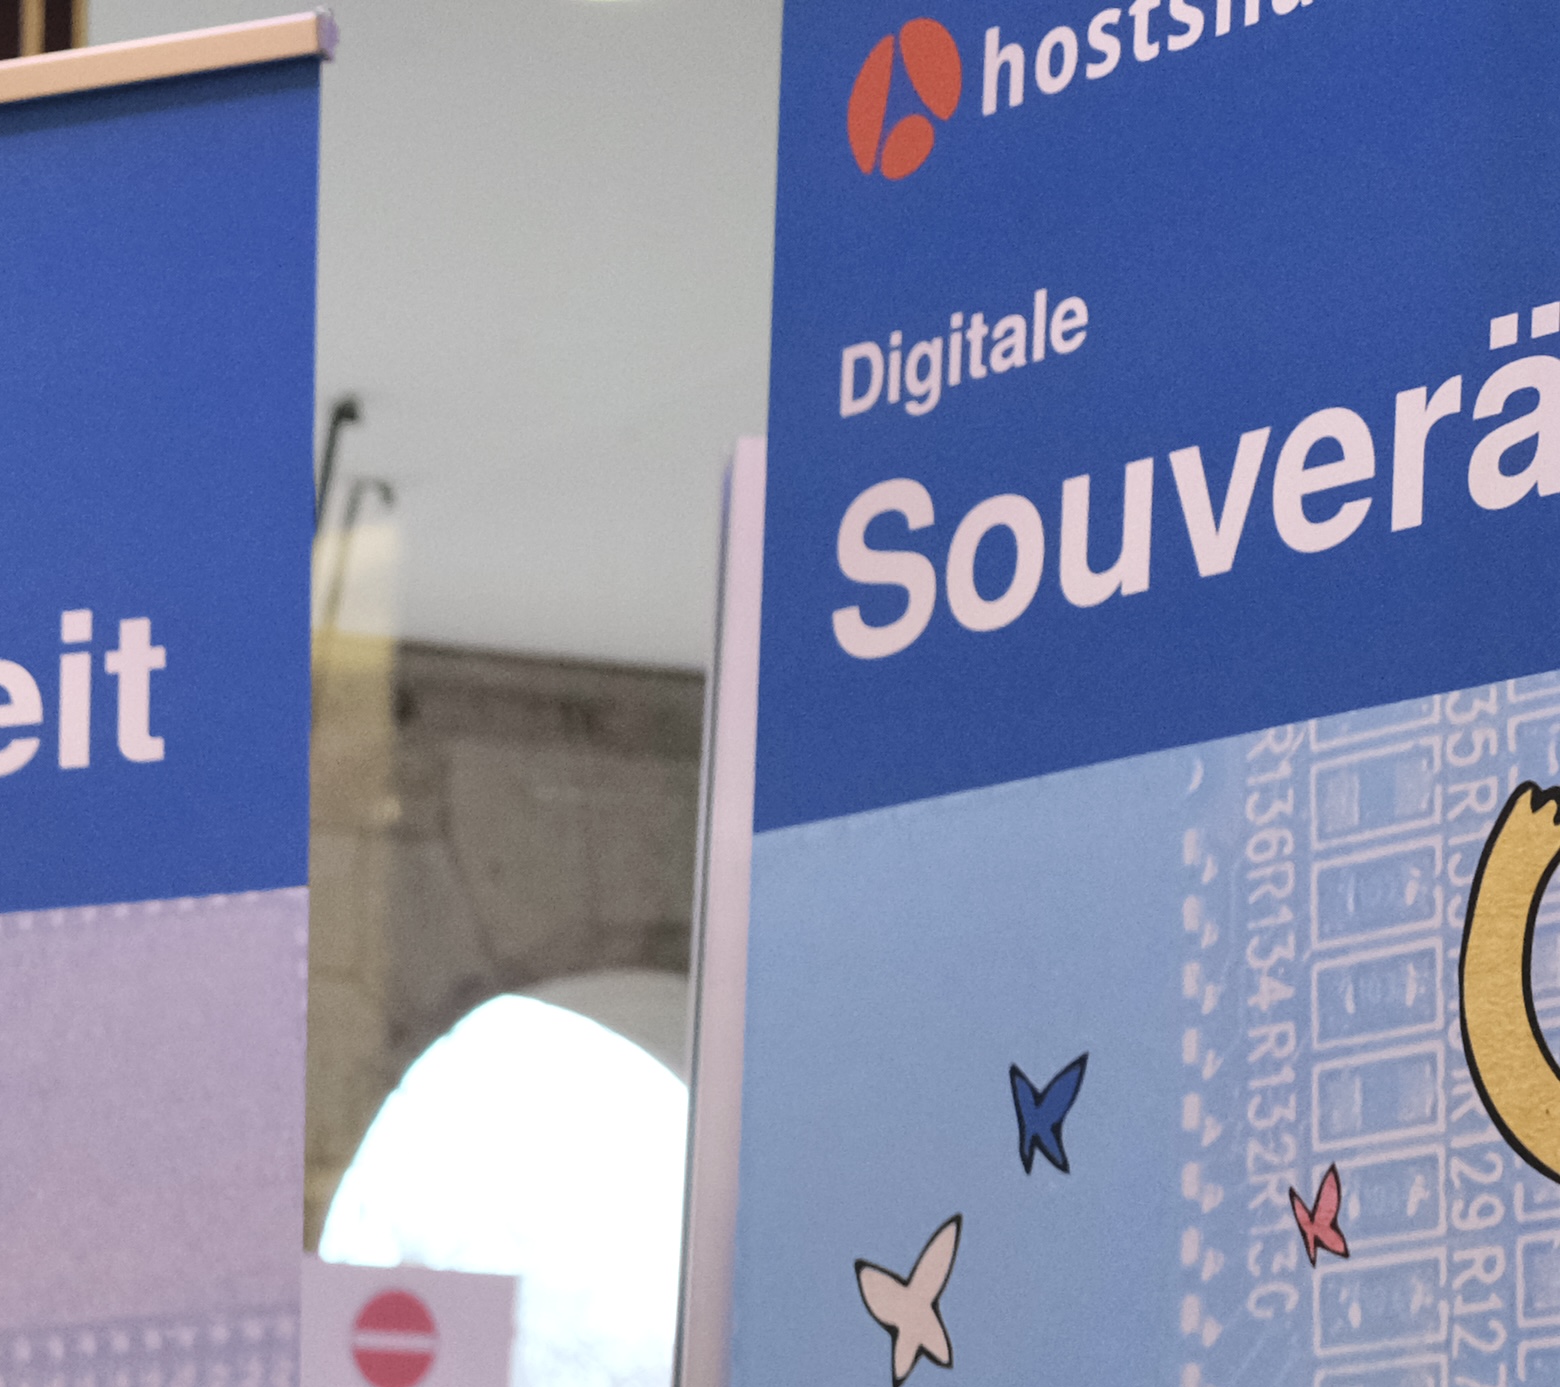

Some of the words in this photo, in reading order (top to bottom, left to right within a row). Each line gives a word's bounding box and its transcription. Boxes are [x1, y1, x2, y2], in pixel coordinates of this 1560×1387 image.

[982, 0, 1314, 117] hosts
[839, 287, 1090, 418] Digitale
[831, 302, 1560, 661] Souverä
